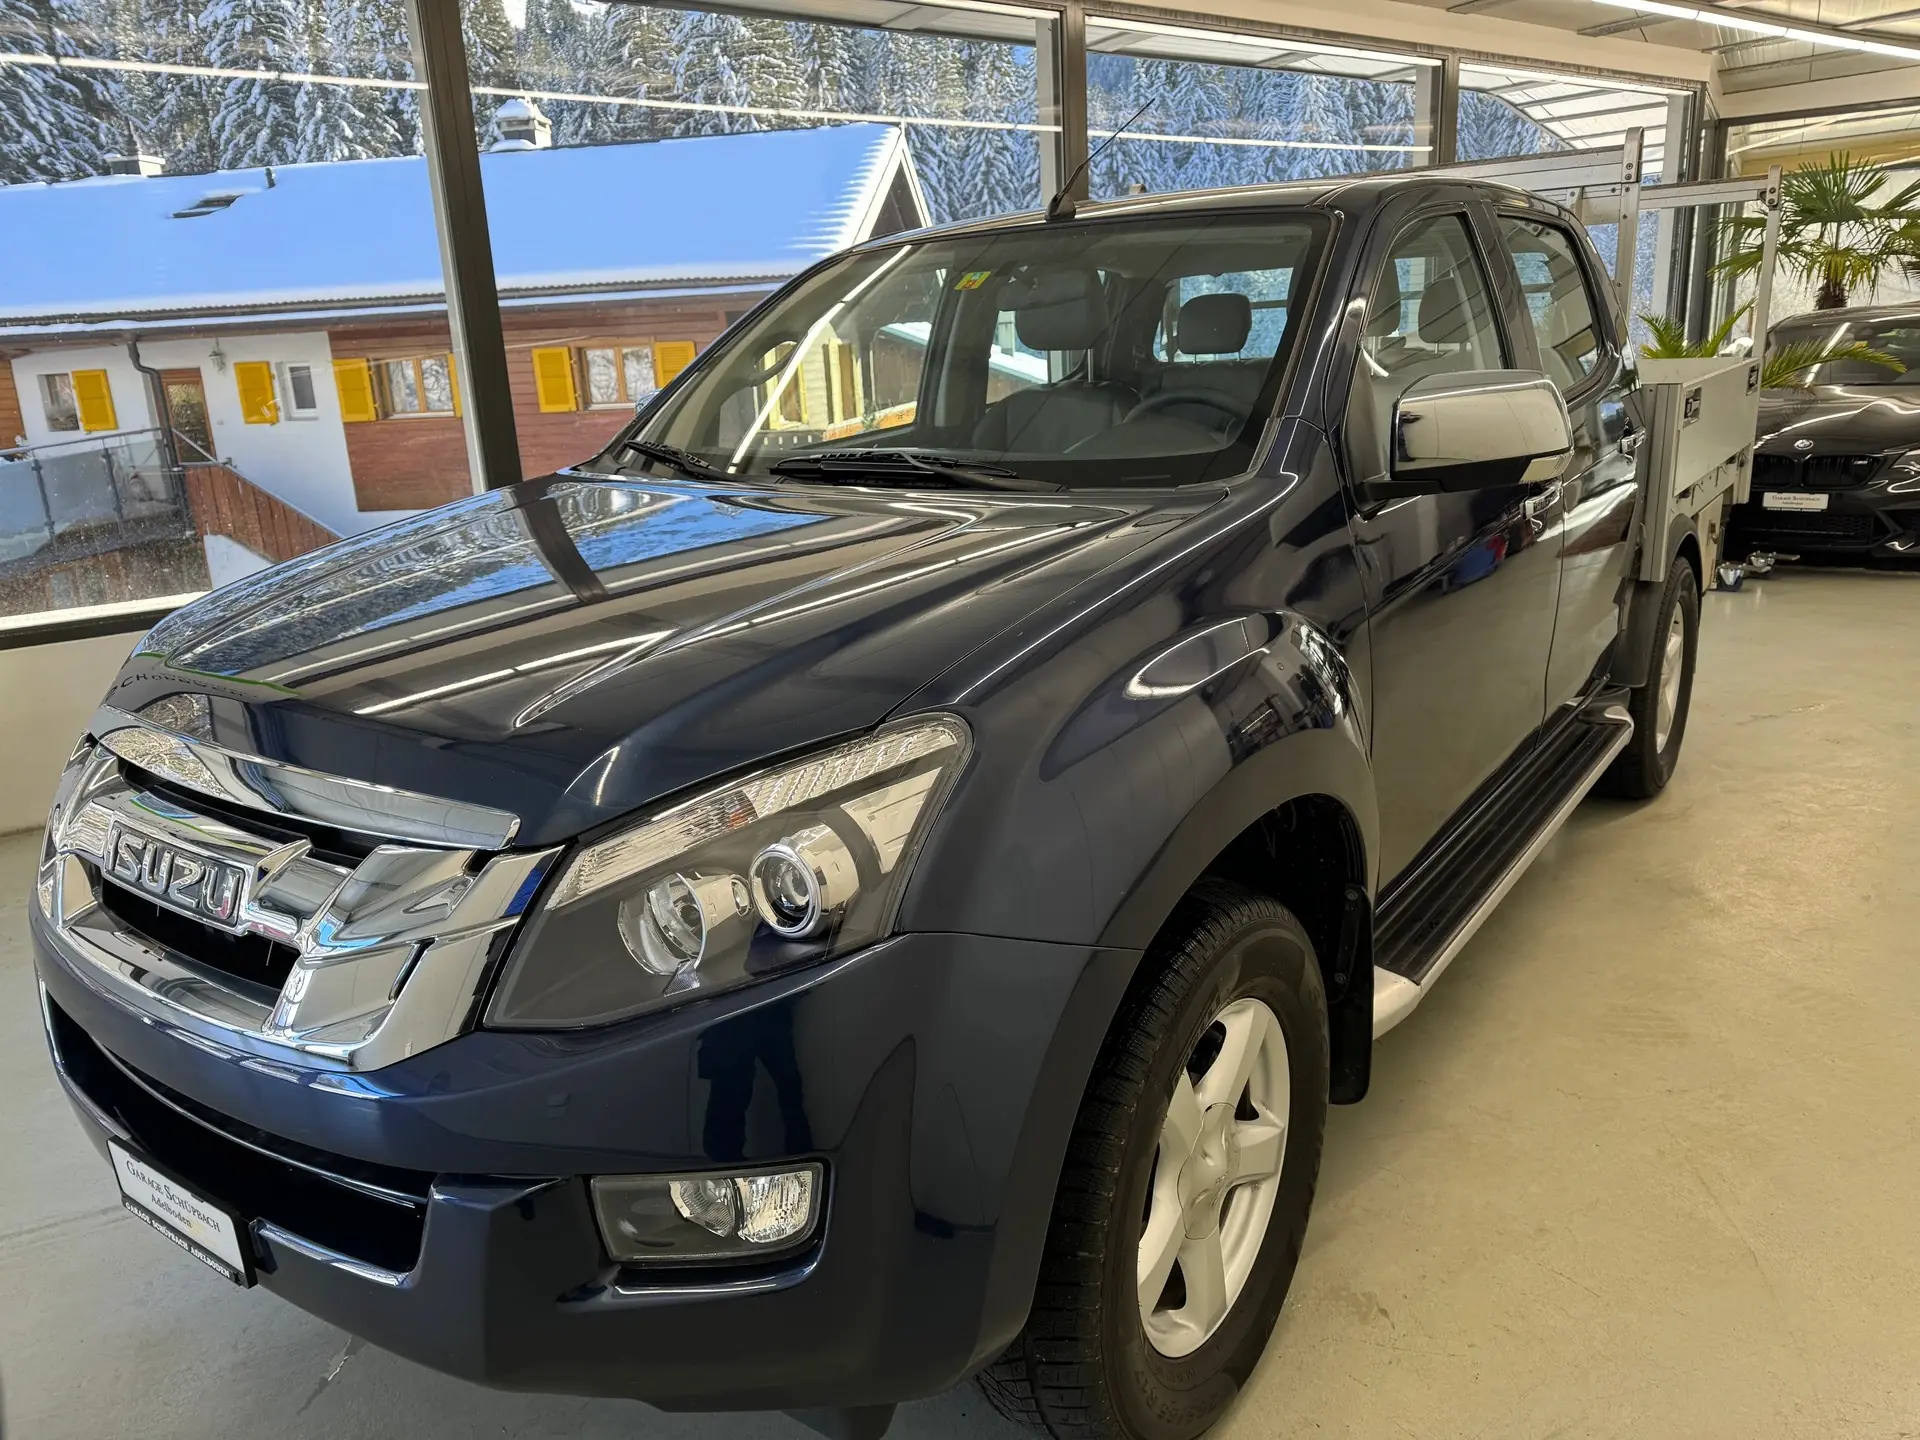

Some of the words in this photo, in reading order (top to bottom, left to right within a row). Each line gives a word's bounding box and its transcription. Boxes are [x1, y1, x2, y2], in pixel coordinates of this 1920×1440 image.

[107, 829, 240, 919] ISUZU
[126, 1160, 164, 1195] GARAGE
[151, 1194, 193, 1228] Adelboden
